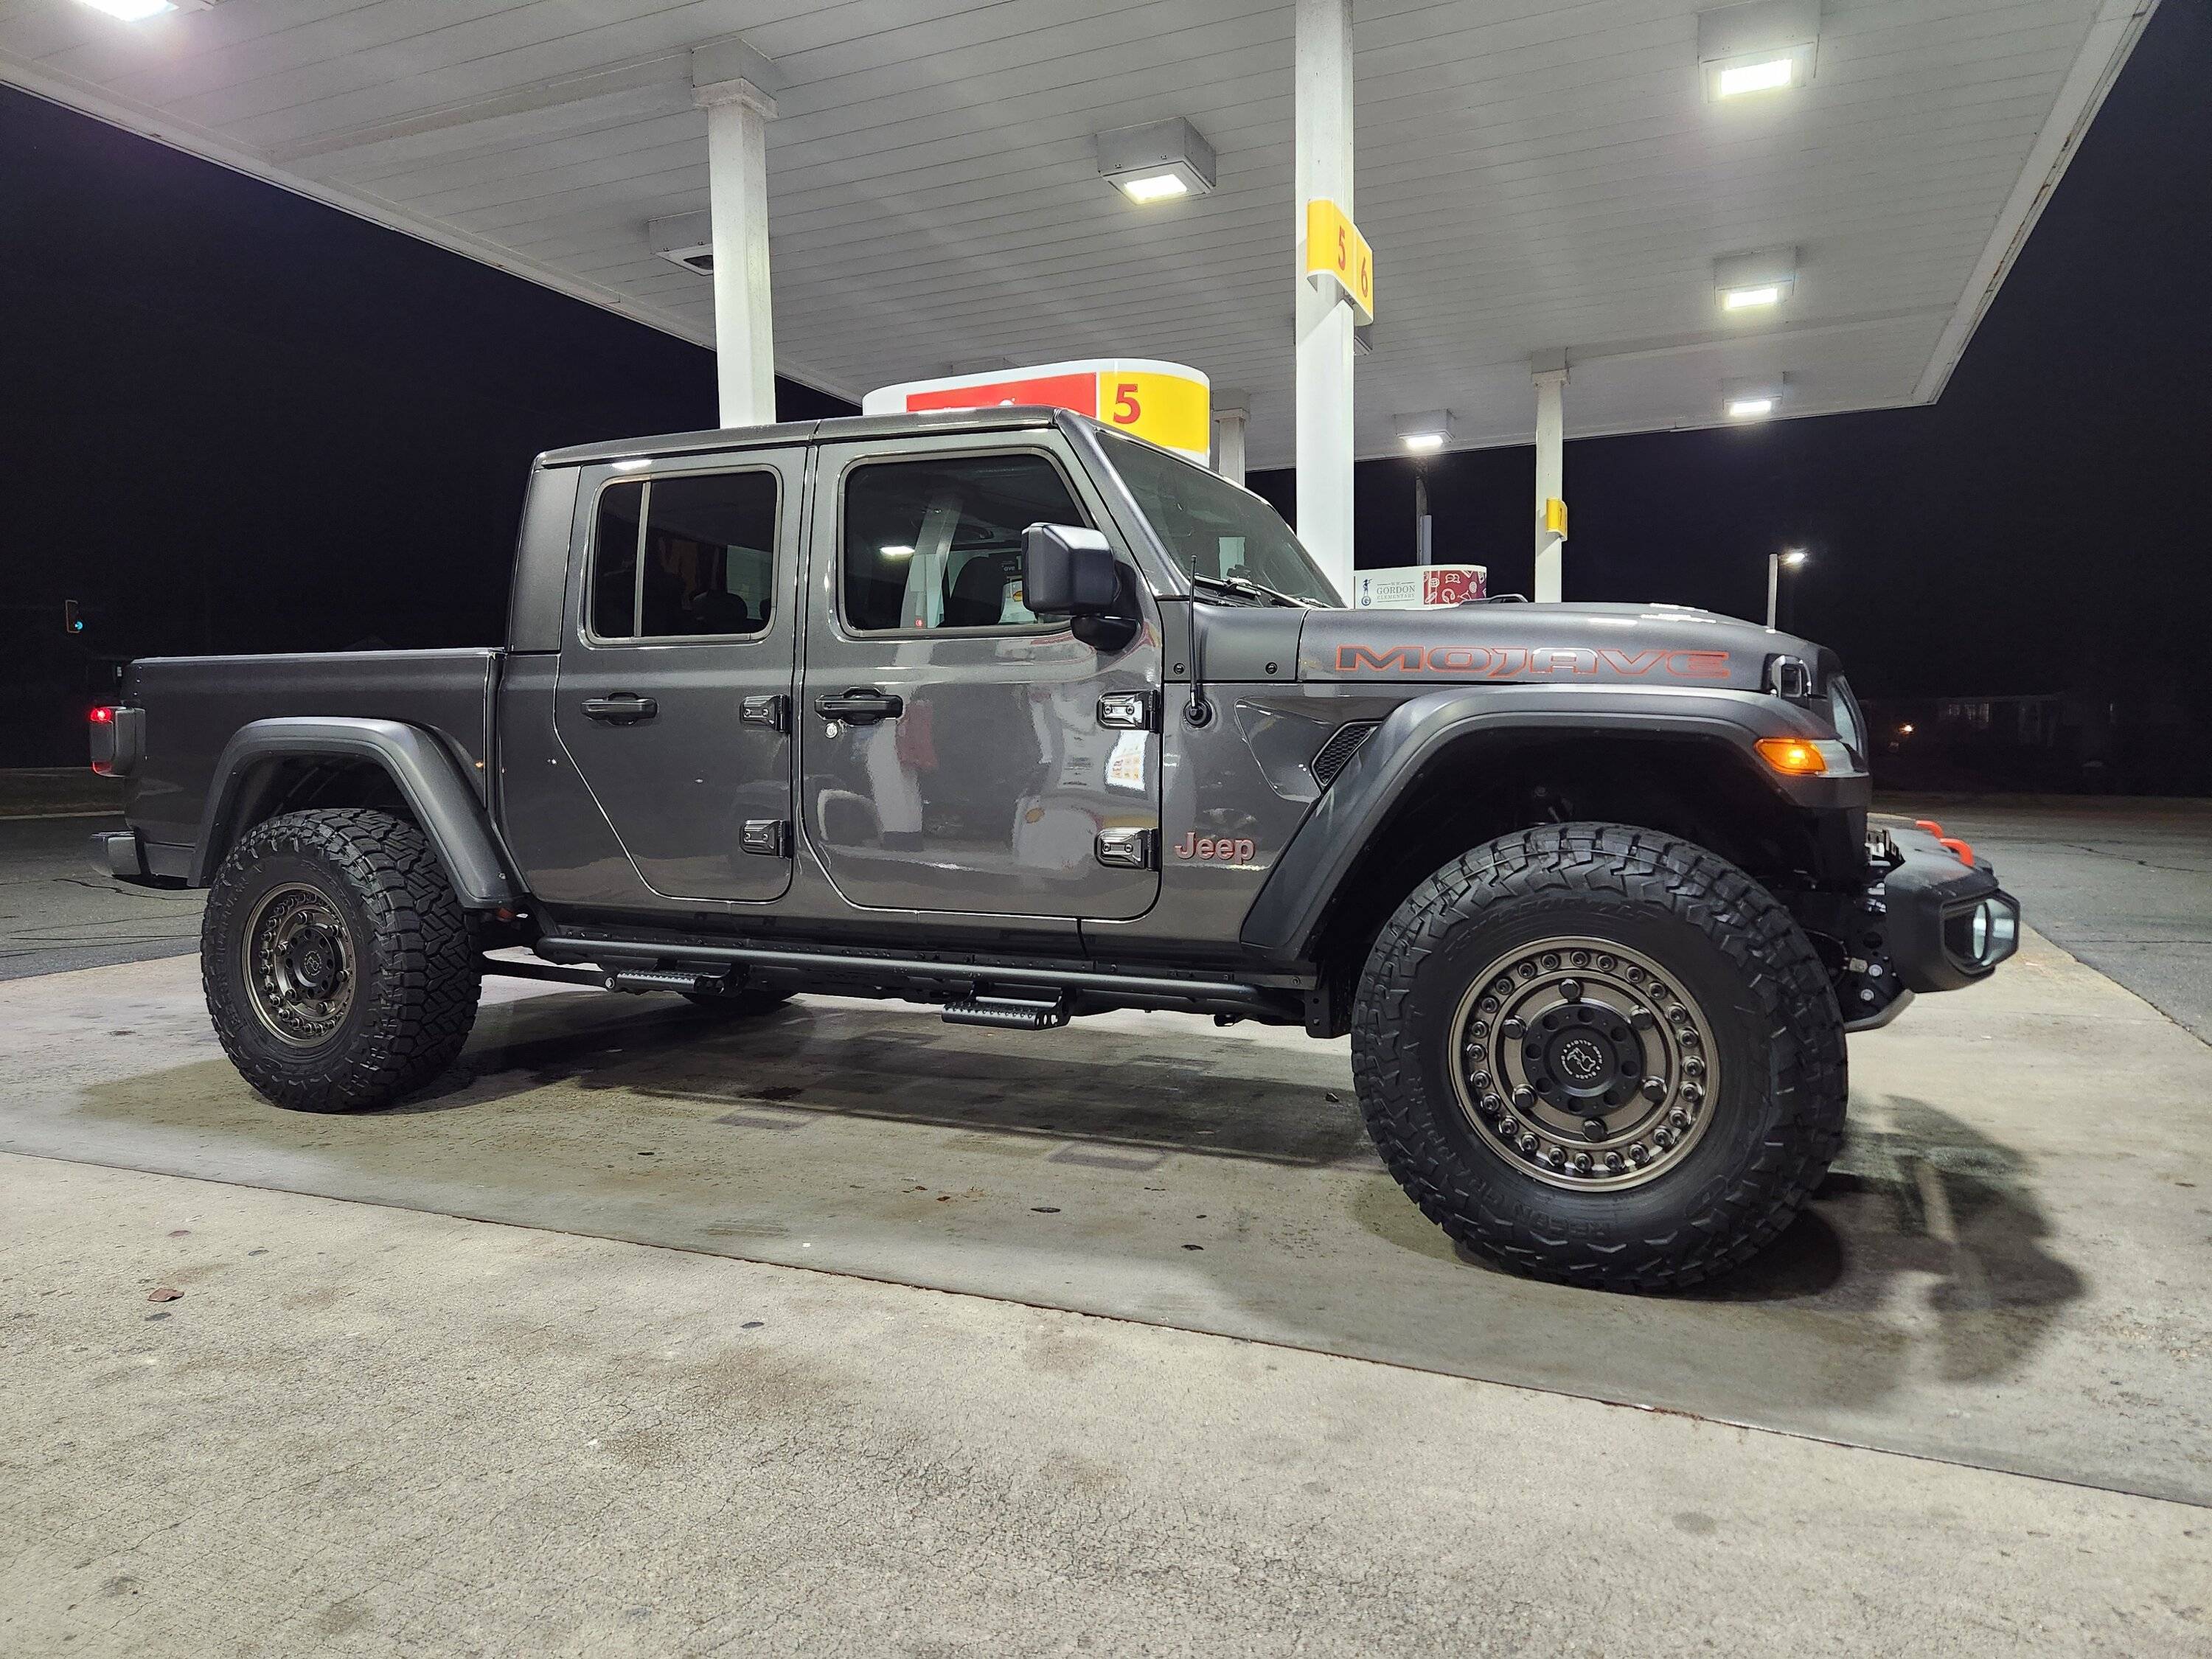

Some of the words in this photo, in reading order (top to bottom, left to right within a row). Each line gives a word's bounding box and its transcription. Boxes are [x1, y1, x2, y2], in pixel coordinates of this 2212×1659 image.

[1338, 225, 1346, 271] 5
[1361, 257, 1368, 298] 6
[1113, 383, 1141, 424] 5
[1377, 585, 1415, 595] GORDON
[1335, 644, 1731, 679] MOJAVE
[1175, 832, 1255, 865] Jeep
